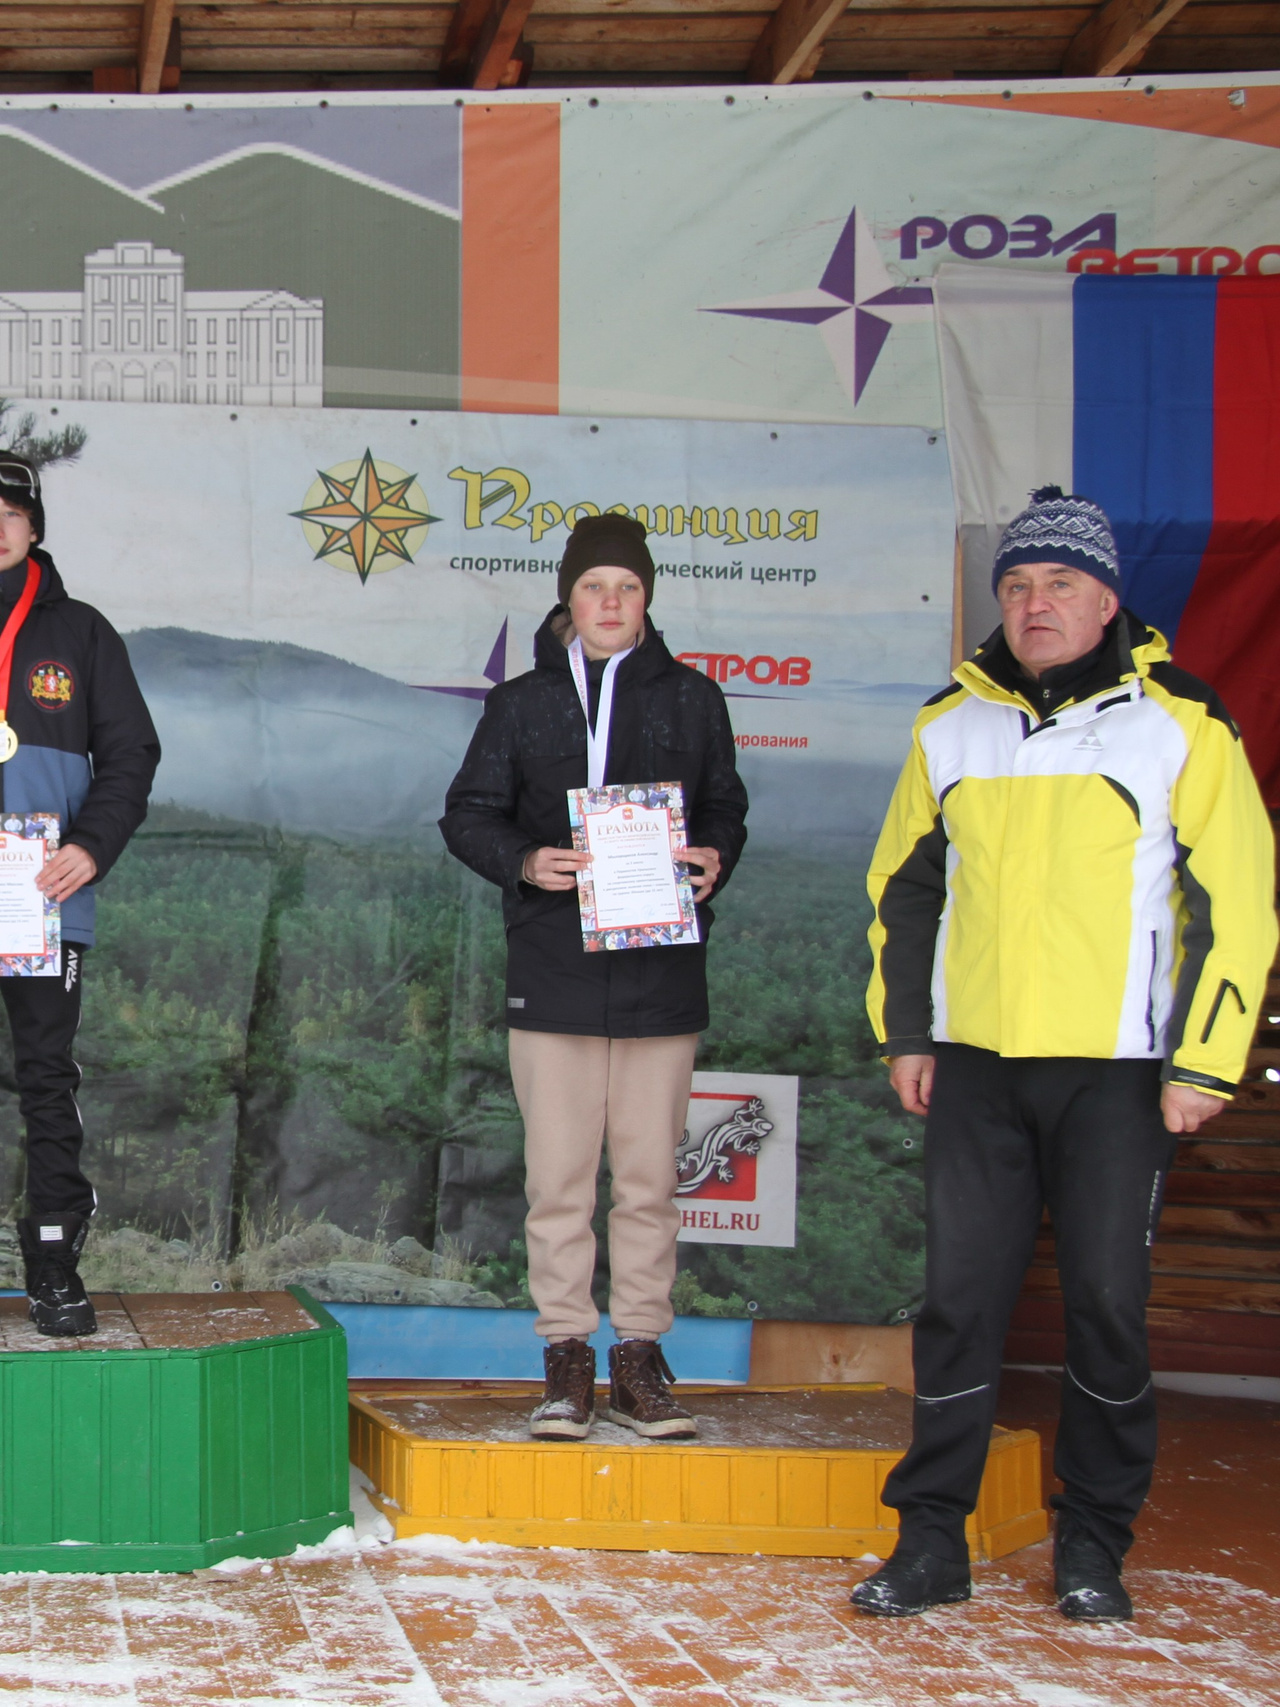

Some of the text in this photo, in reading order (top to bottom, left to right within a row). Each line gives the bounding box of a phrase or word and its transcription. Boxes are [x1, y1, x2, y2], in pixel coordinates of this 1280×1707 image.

[900, 213, 1117, 260] РОЗА
[751, 566, 817, 587] центр
[734, 734, 808, 749] ирования
[597, 821, 660, 836] ГРАМОТА
[681, 1209, 761, 1231] HEL.RU
